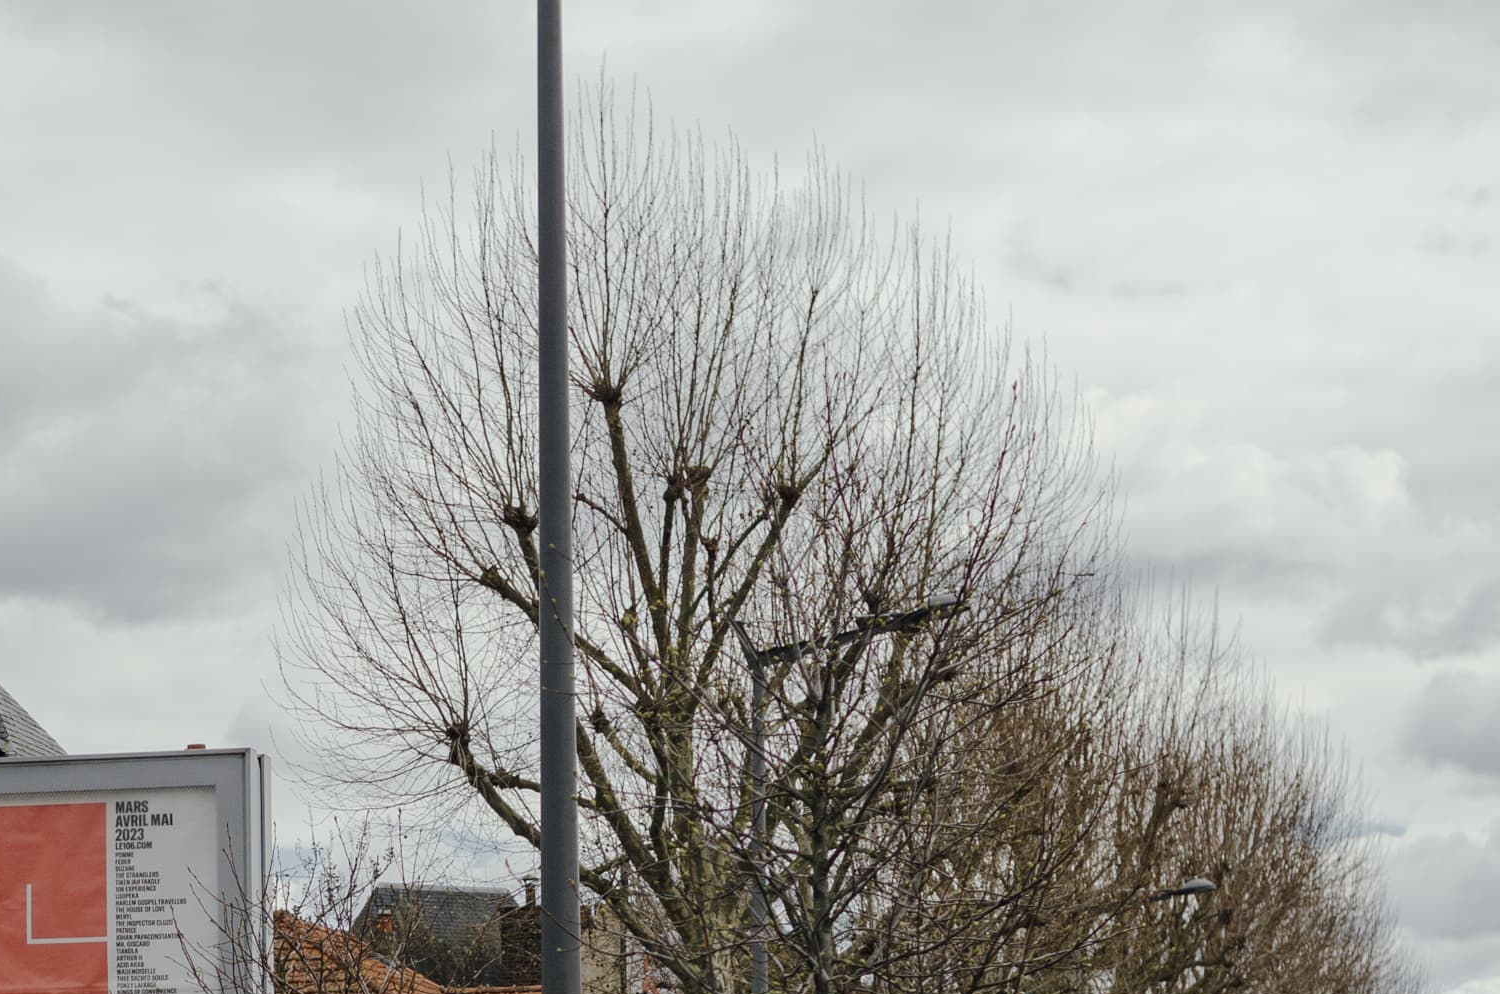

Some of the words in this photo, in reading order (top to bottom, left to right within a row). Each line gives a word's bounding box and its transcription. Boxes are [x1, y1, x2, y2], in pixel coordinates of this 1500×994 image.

[115, 801, 149, 814] MARS
[115, 814, 149, 828] AVRIL
[151, 813, 173, 826] MAI
[115, 828, 145, 841] 2023
[115, 841, 153, 850] LE106.COM
